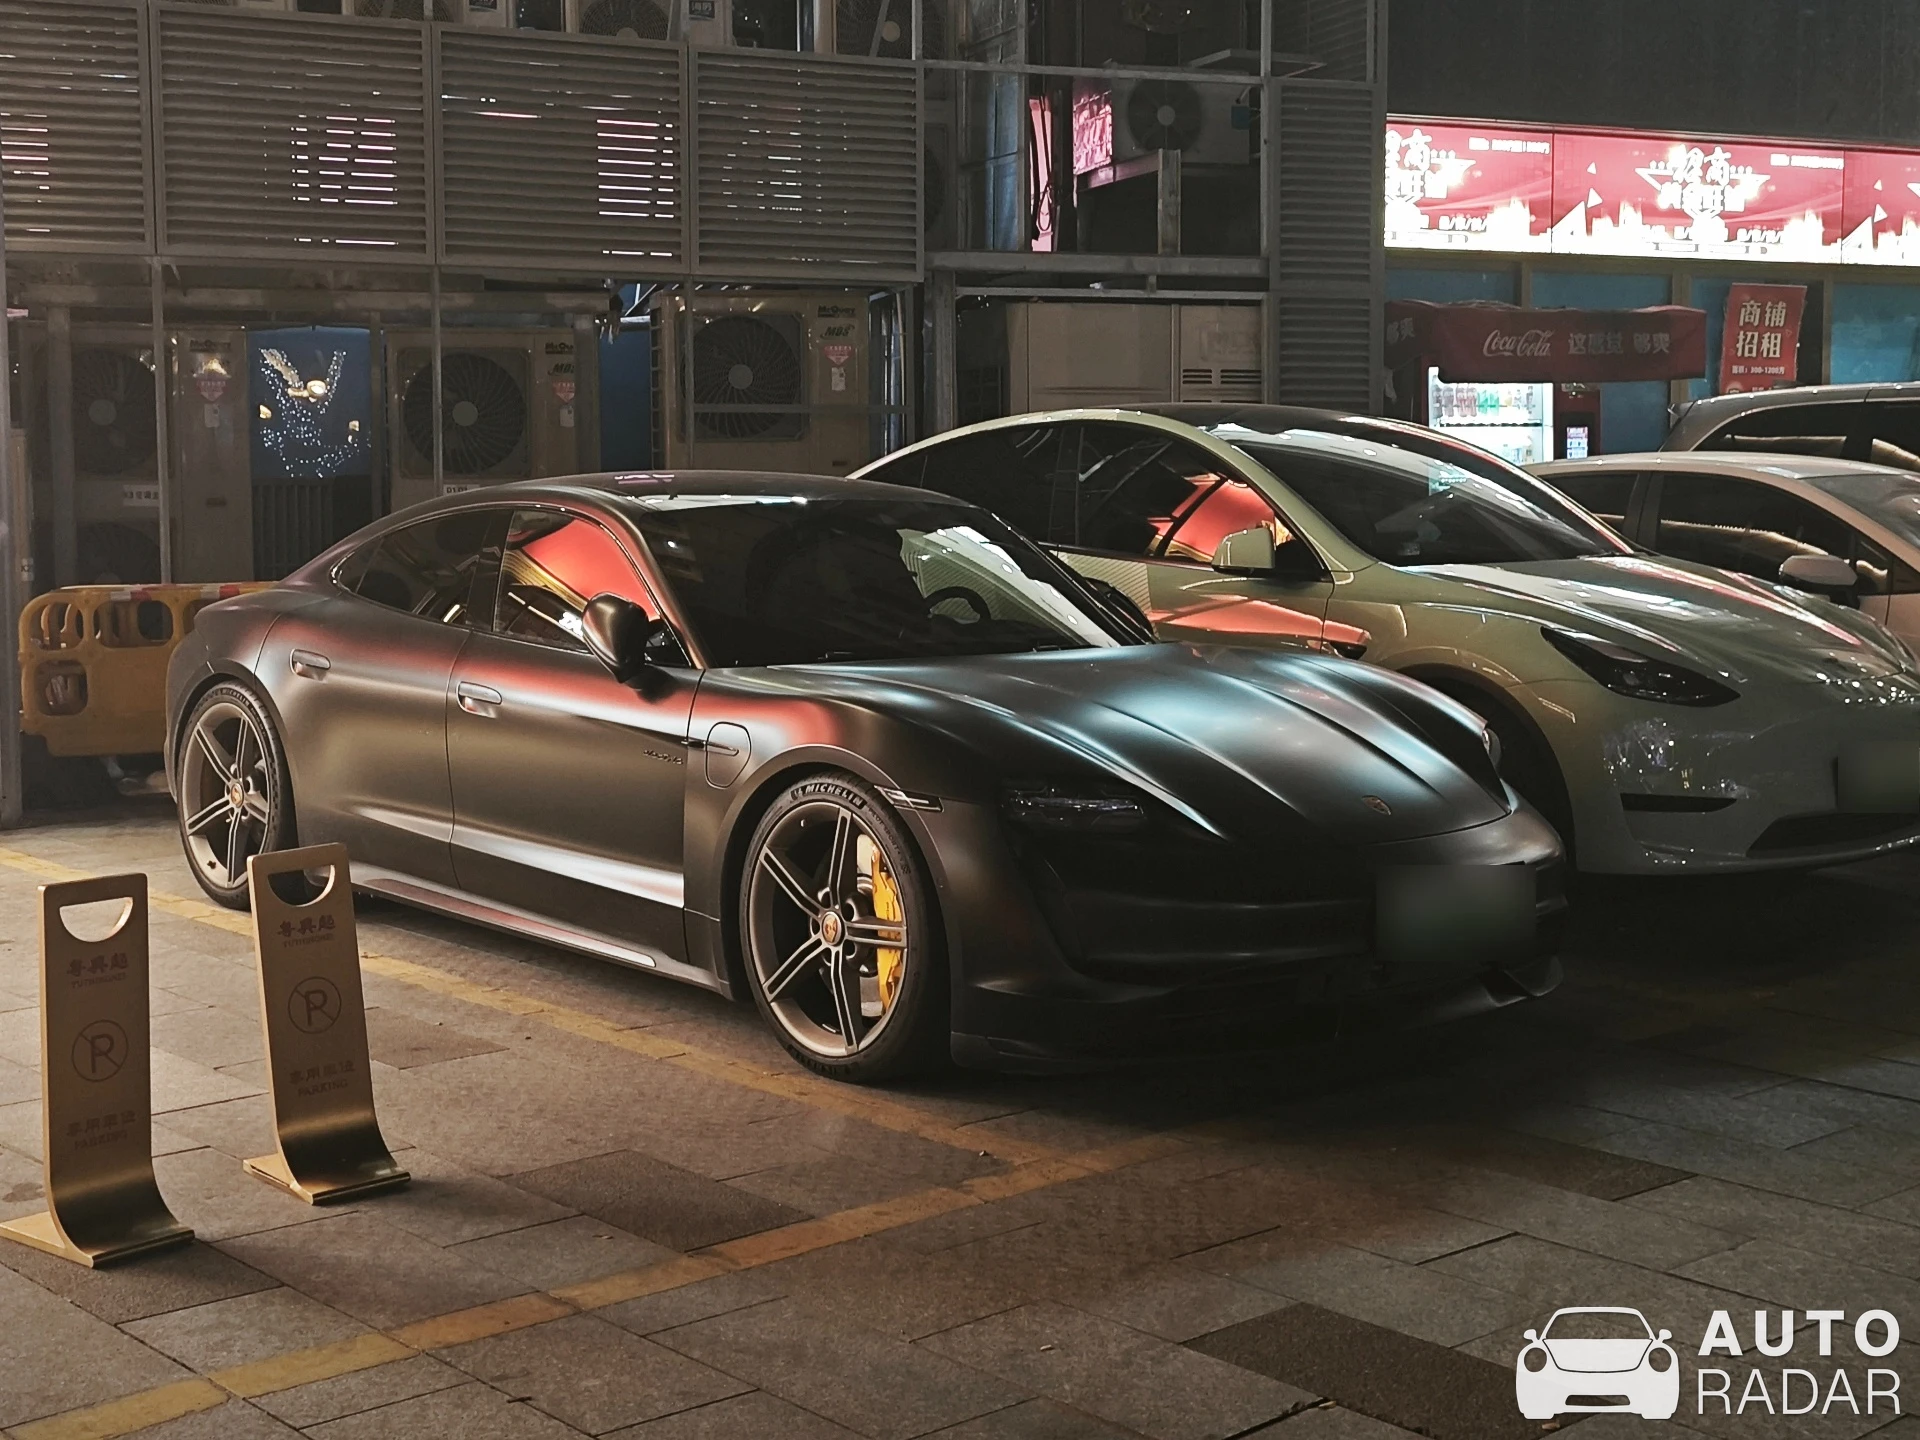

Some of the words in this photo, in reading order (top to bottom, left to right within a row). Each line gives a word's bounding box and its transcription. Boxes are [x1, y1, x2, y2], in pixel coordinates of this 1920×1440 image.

[1739, 300, 1787, 327] 商铺
[1483, 329, 1555, 357] Coca-Cola
[1568, 332, 1623, 355] 这感觉
[1736, 329, 1782, 358] 招租
[805, 783, 863, 806] MICHELIN
[298, 1078, 349, 1098] PARKING
[76, 1129, 130, 1150] PARKING
